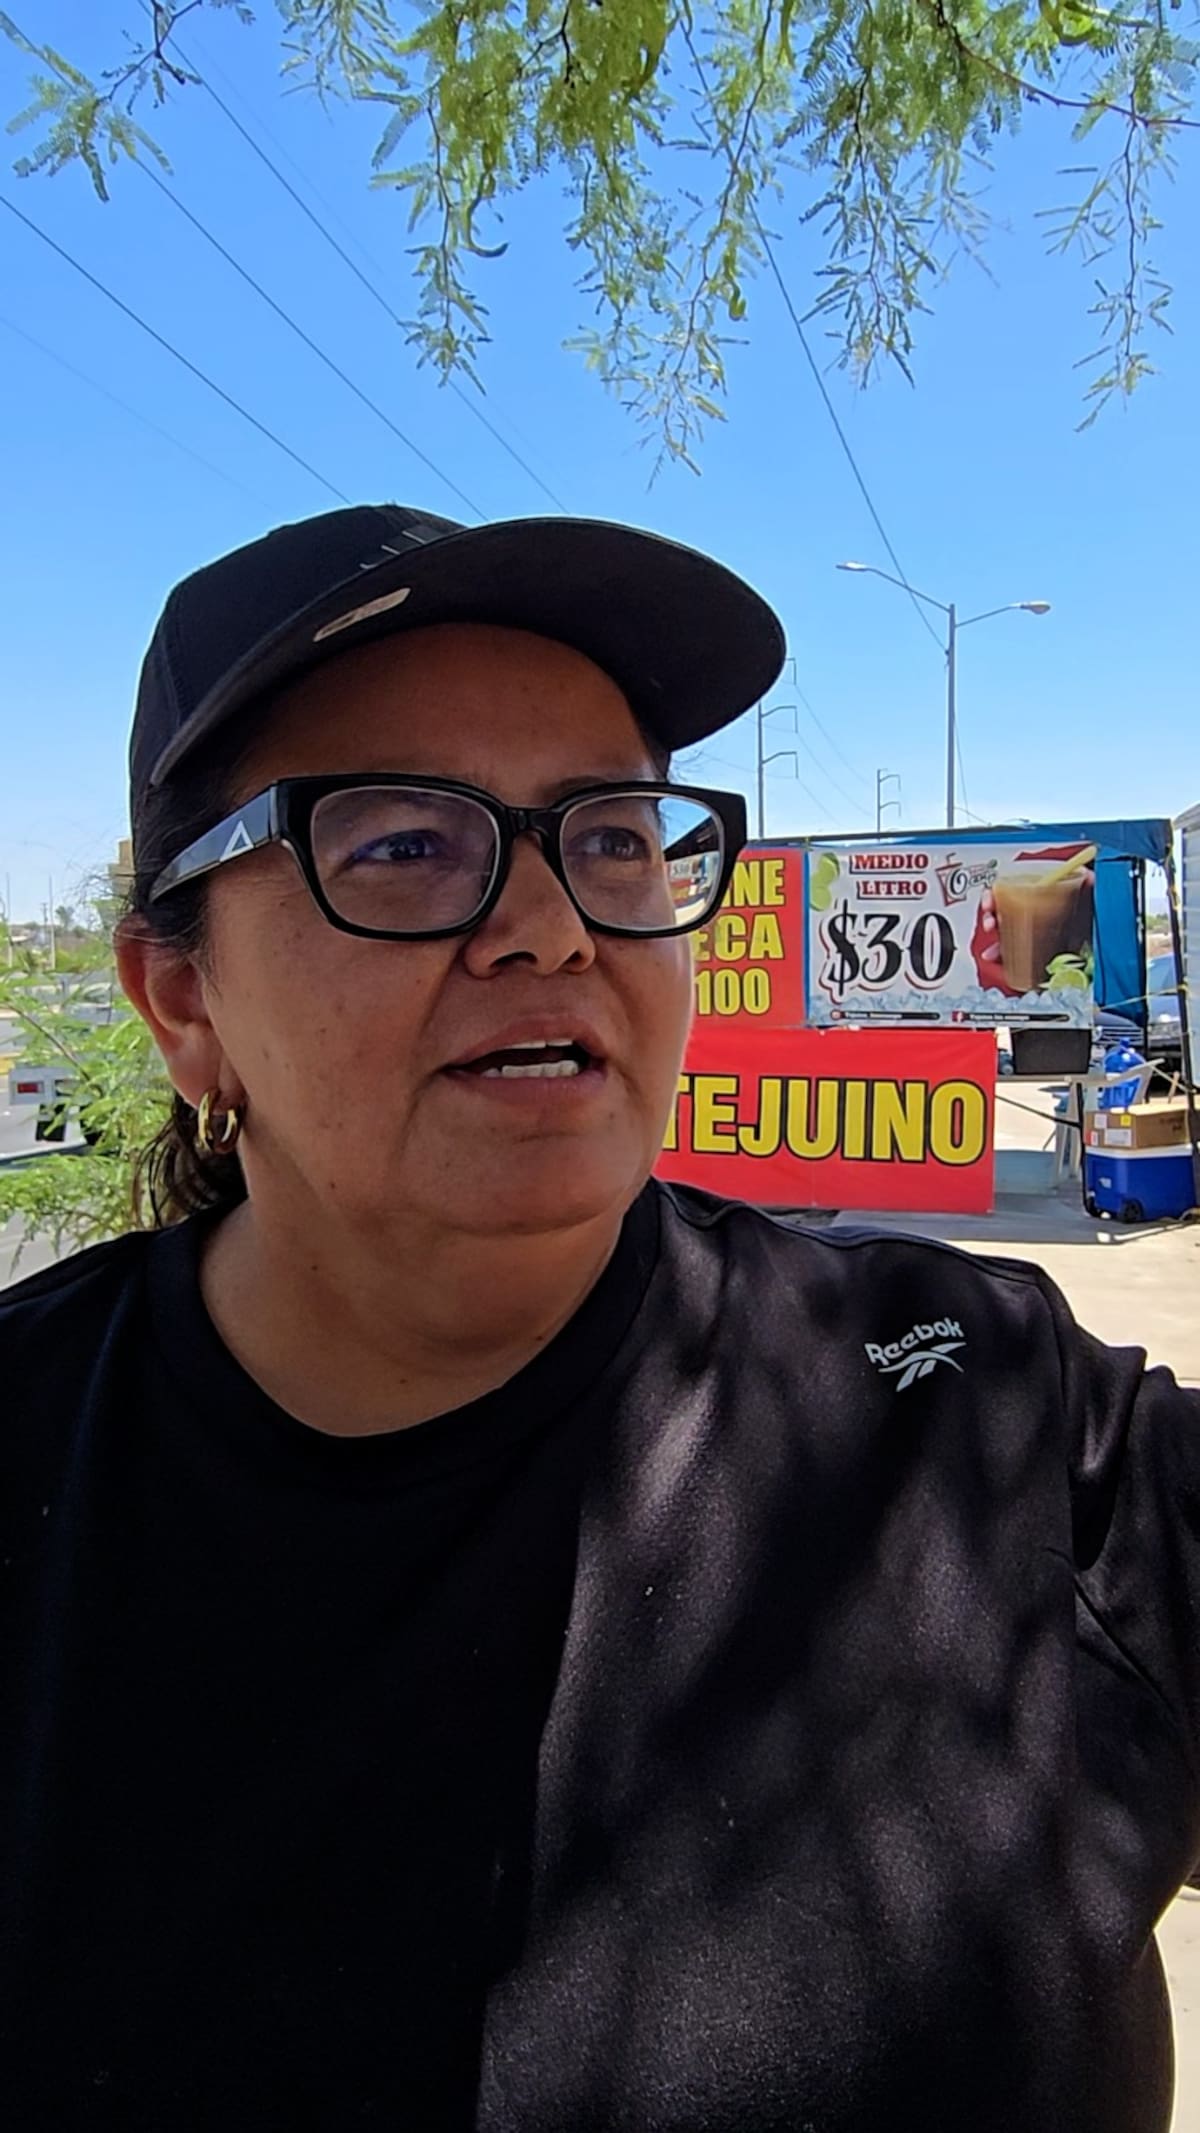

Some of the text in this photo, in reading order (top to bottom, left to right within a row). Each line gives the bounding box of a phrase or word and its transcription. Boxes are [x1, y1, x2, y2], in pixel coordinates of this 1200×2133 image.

[721, 858, 786, 908] NE
[853, 853, 929, 870] MEDIO
[860, 879, 928, 896] LITRO
[826, 898, 958, 997] $30
[694, 966, 772, 1017] 100
[864, 1316, 965, 1366] Reebok
